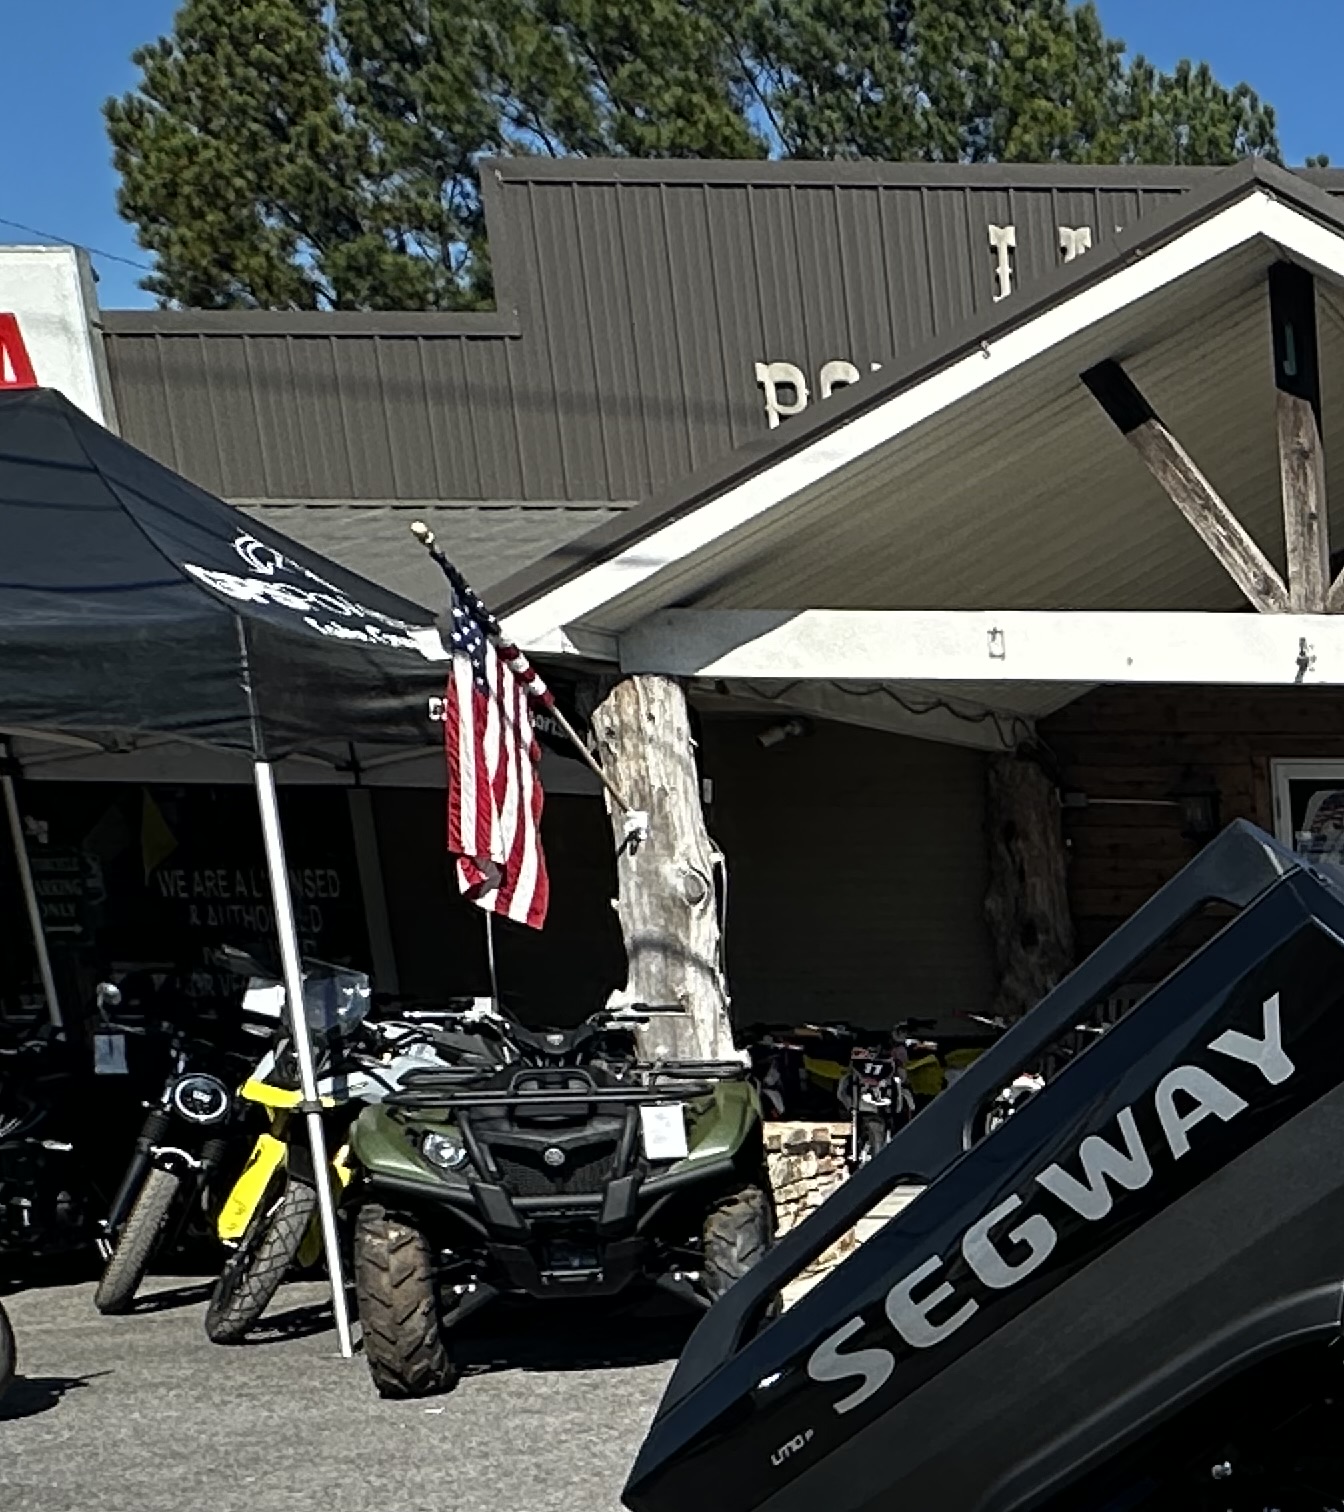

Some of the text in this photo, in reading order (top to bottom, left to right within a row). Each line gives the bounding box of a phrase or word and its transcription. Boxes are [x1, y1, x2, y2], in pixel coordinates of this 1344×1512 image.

[35, 878, 83, 896] ARKING
[156, 868, 340, 898] WE ARE A LNSED
[206, 904, 324, 934] AUTHOED
[807, 992, 1295, 1414] SEGWAY
